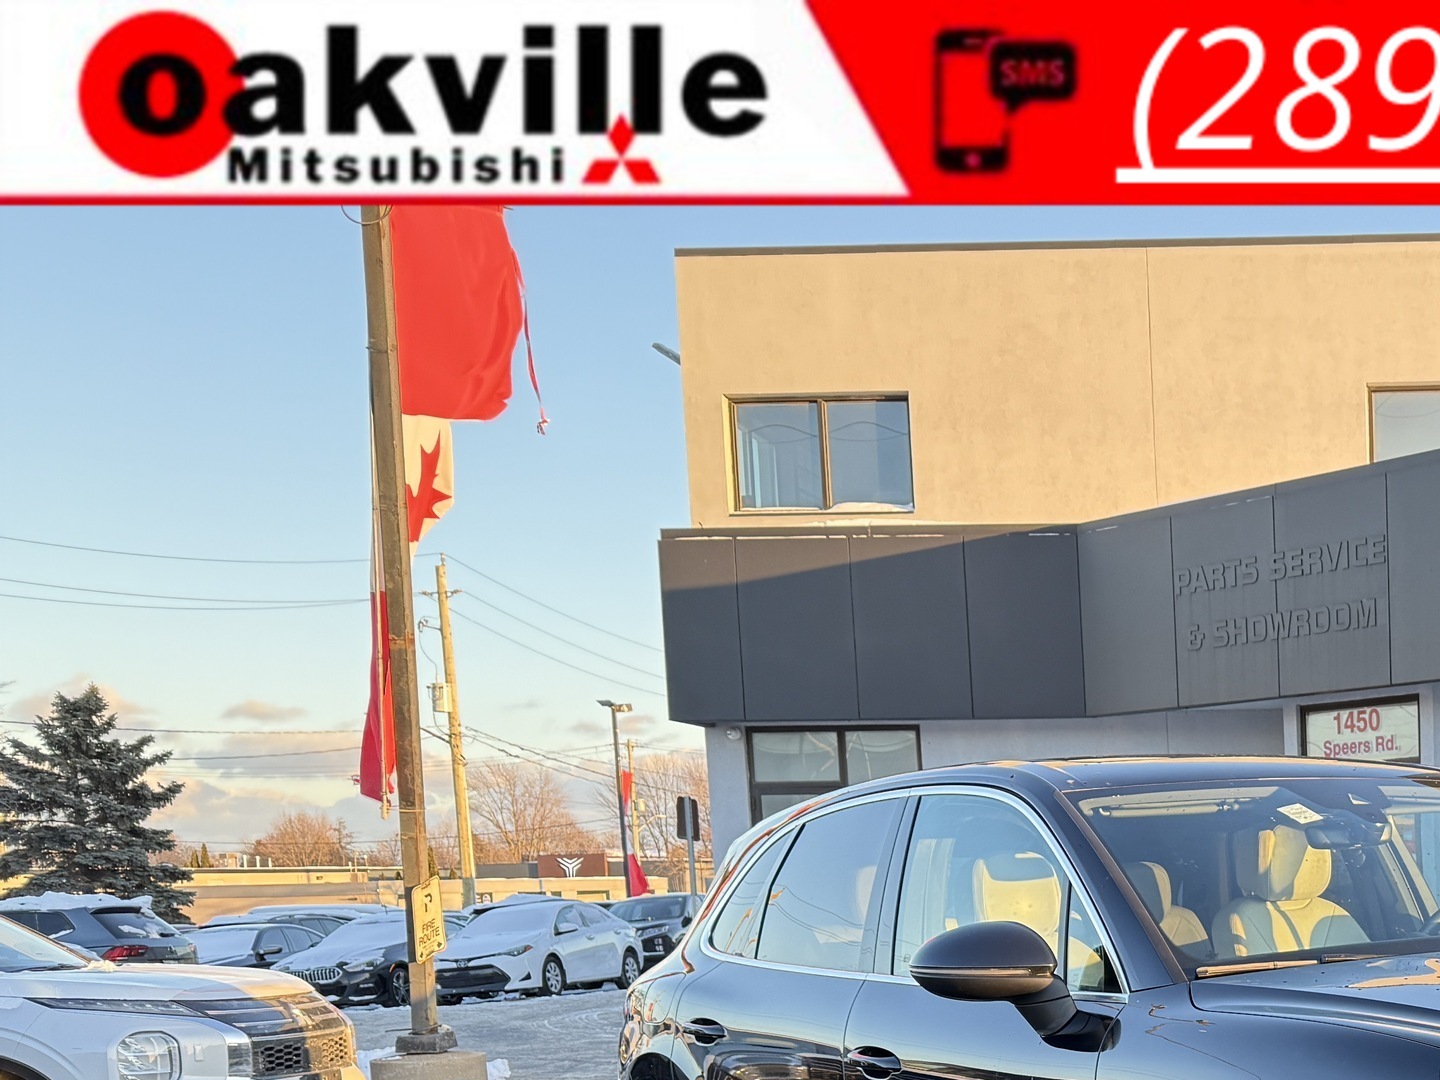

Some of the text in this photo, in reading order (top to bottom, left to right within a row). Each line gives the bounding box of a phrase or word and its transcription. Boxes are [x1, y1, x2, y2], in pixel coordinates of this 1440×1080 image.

[1175, 534, 1387, 599] PARTS SERVICE
[1187, 597, 1378, 651] & SHOWROOM
[1333, 708, 1381, 735] 1450
[1323, 734, 1398, 758] Speers Rd.
[419, 926, 440, 947] ROUTE
[422, 918, 435, 934] FIRE
